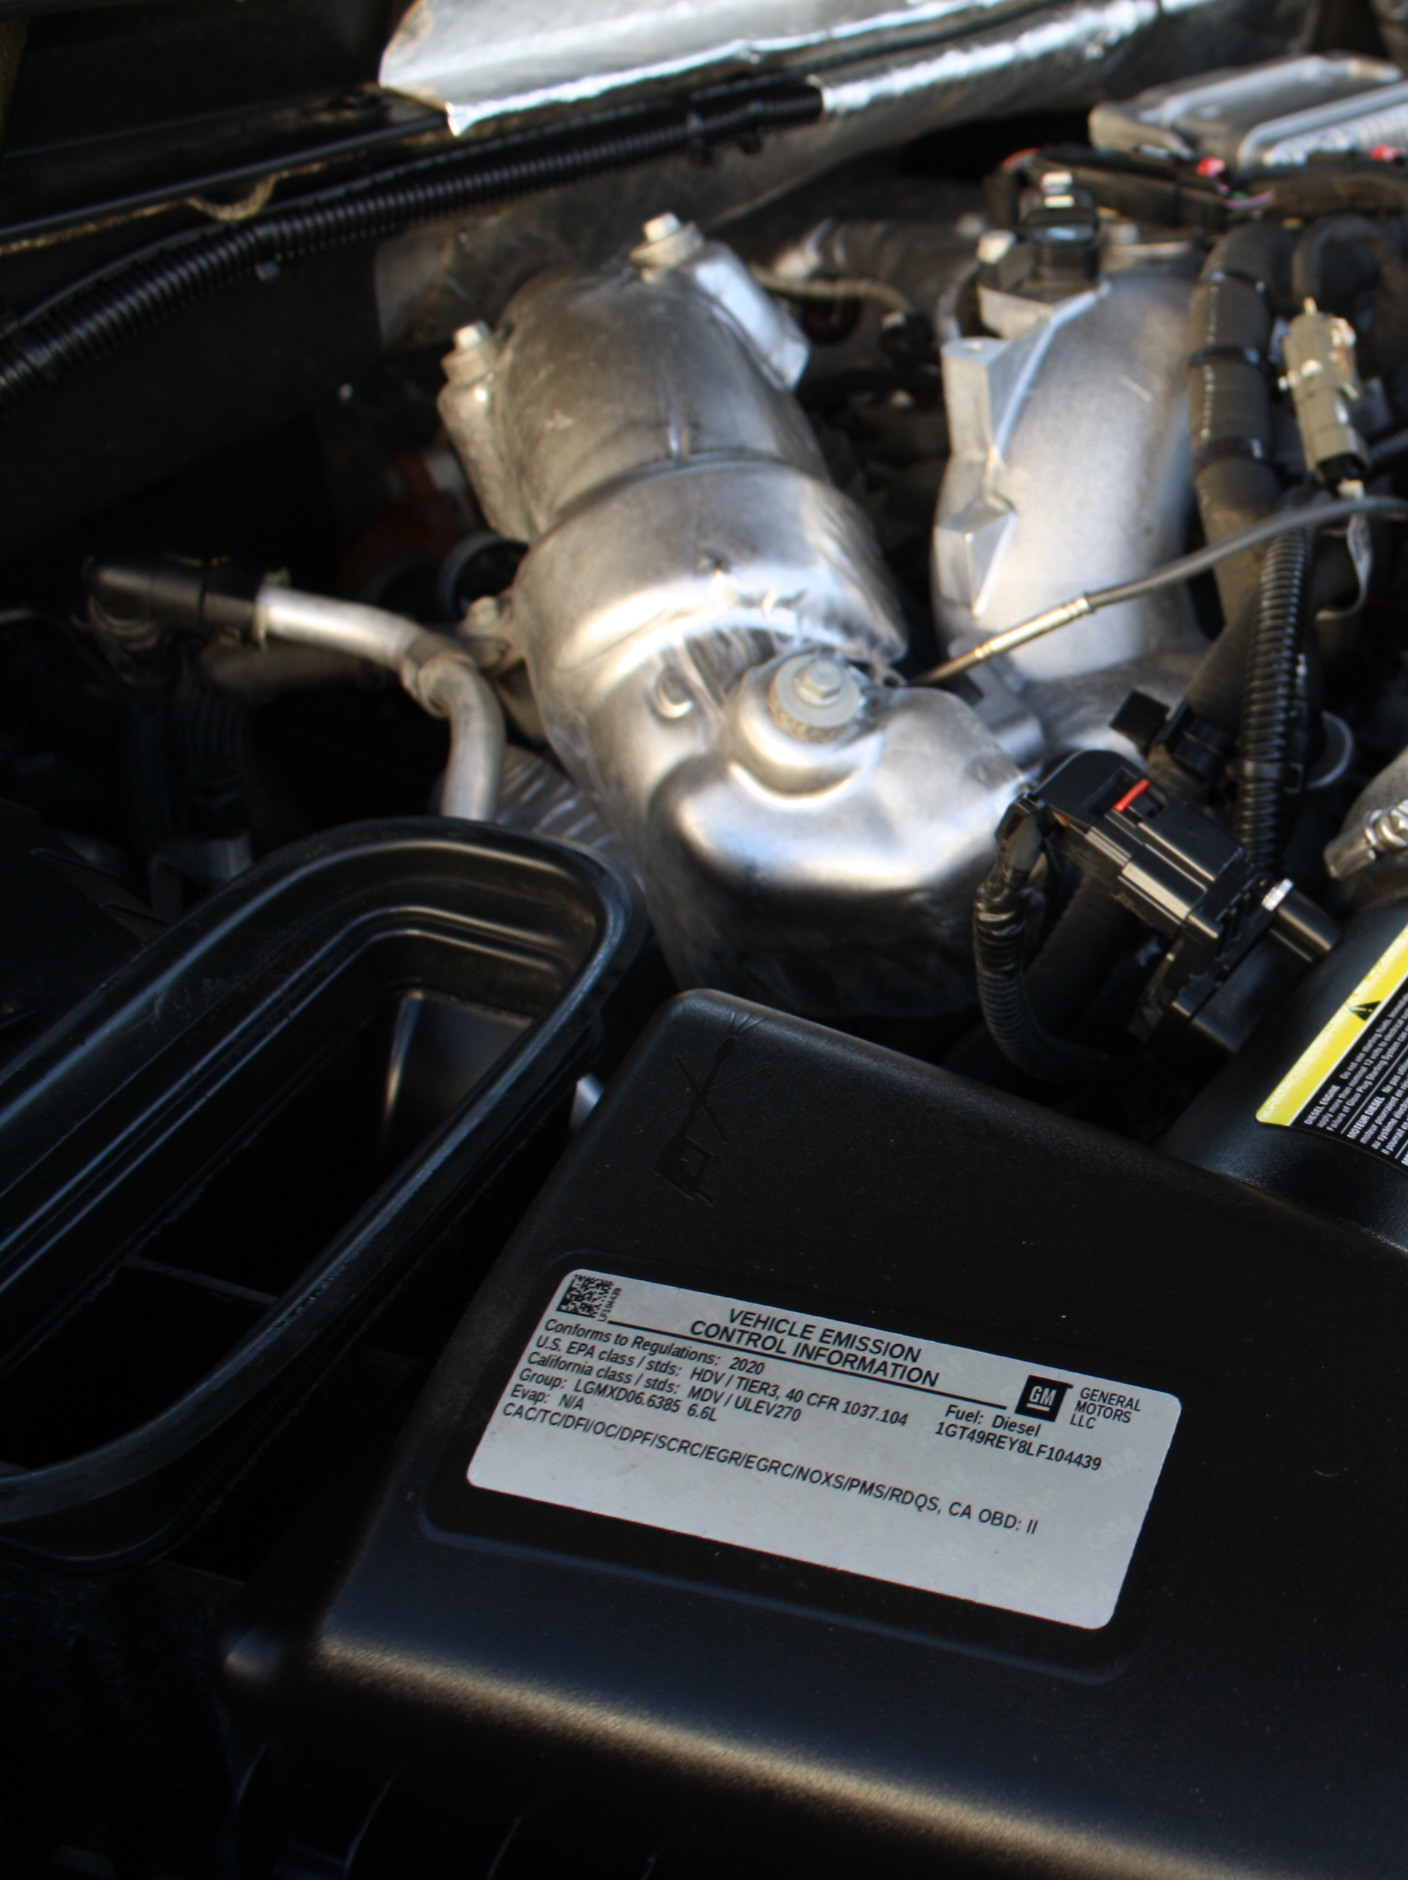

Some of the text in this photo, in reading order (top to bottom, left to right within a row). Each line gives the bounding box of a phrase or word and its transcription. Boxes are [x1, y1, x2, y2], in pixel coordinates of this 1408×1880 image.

[1303, 1103, 1324, 1124] DIESEL
[1319, 1084, 1340, 1105] ENGINE
[1326, 1112, 1346, 1131] Failure
[1345, 1092, 1361, 1106] Glow
[1355, 1080, 1372, 1092] Plug
[1365, 1059, 1388, 1082] Starting
[1380, 1041, 1400, 1062] System
[1346, 1114, 1370, 1138] MOTEUR
[1364, 1096, 1385, 1115] DIESEL
[1381, 1084, 1393, 1093] Ne
[1388, 1074, 1401, 1086] pas
[1359, 1123, 1377, 1143] moteur
[1374, 1096, 1398, 1125] pourraient
[1394, 1088, 1404, 1097] en
[1371, 1140, 1381, 1149] au
[1377, 1117, 1397, 1141] système
[1385, 1128, 1405, 1151] pourrait
[544, 1318, 765, 1375] Conforms to Regulations: 2020
[690, 1320, 938, 1386] CONTROL INFORMATION
[729, 1308, 921, 1362] VEHICLE EMISSION
[510, 1383, 584, 1410] Evap: N/A
[519, 1367, 716, 1421] Group: LGMXD06.6385 6.6L
[527, 1351, 801, 1421] California class / stds: MDV / ULEV270
[535, 1334, 908, 1425] U.S. EPA class / stds: HDV / TIER3, 40 CFR 1037.104
[1080, 1387, 1139, 1411] GENERAL
[945, 1404, 1041, 1436] Fuel: Diesel
[1069, 1412, 1096, 1429] LLC
[1074, 1399, 1131, 1423] MOTORS
[503, 1402, 1038, 1534] CAC/TC/DFI/OC/DPF/SCRC/EGR/EGRC/NOXS/PMS/RDQS, CA OBD: II
[935, 1421, 1101, 1470] 1GT49REY8LF104439
